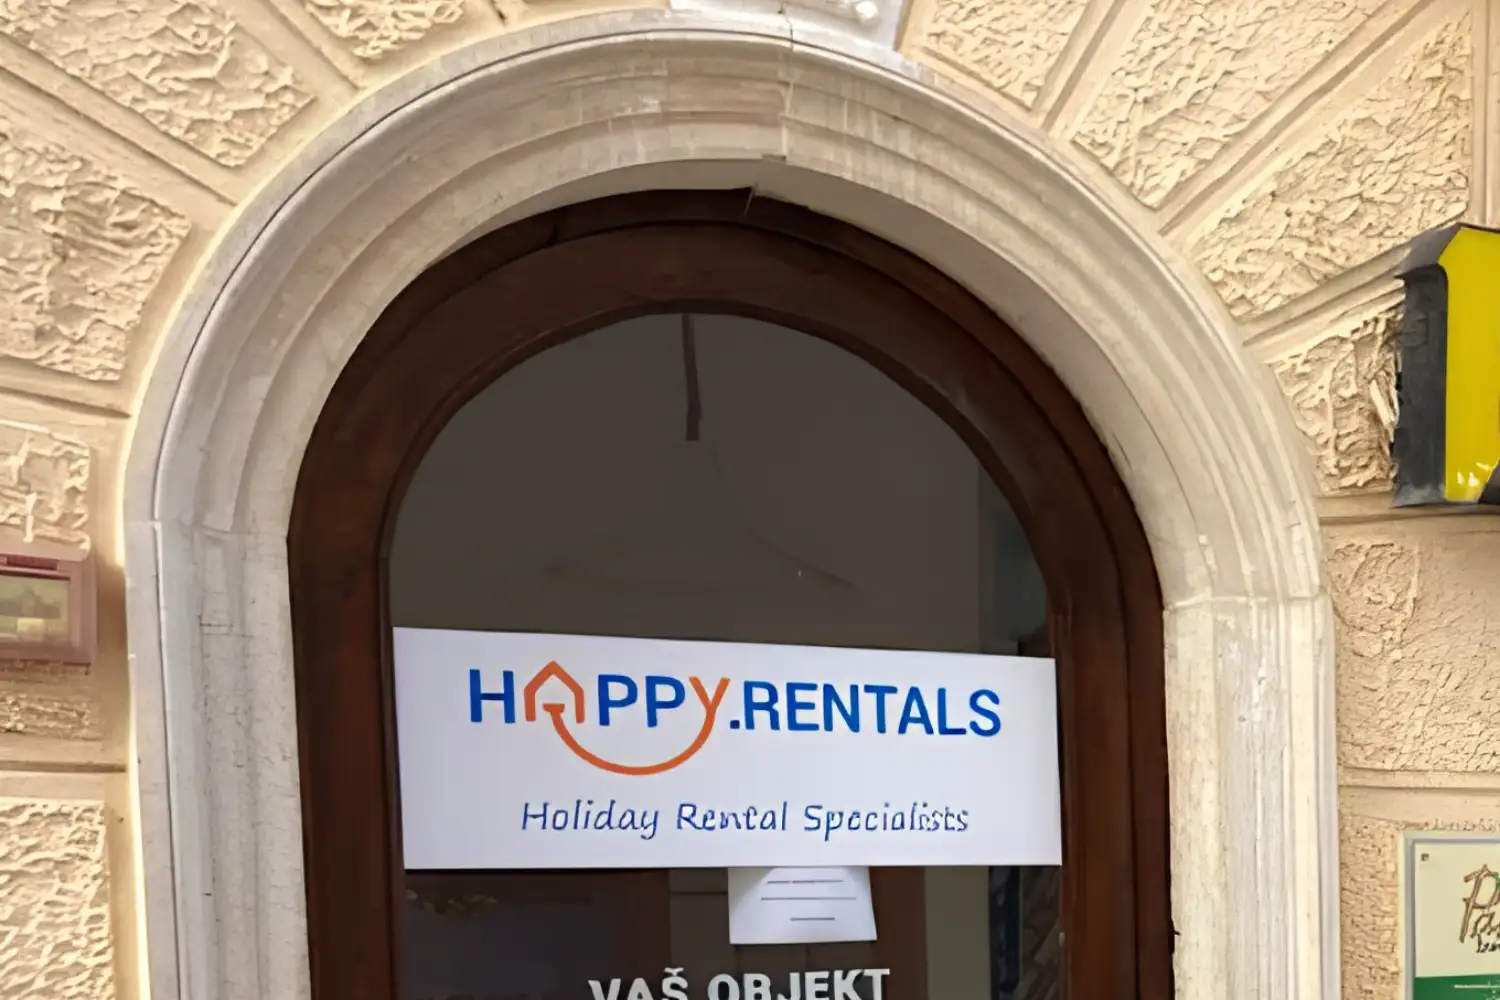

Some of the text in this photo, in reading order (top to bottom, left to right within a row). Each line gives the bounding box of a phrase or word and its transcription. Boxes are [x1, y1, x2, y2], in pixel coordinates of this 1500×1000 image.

[469, 660, 1003, 776] HAPPY.RENTALS
[521, 798, 969, 842] Holiday Rental Specialists
